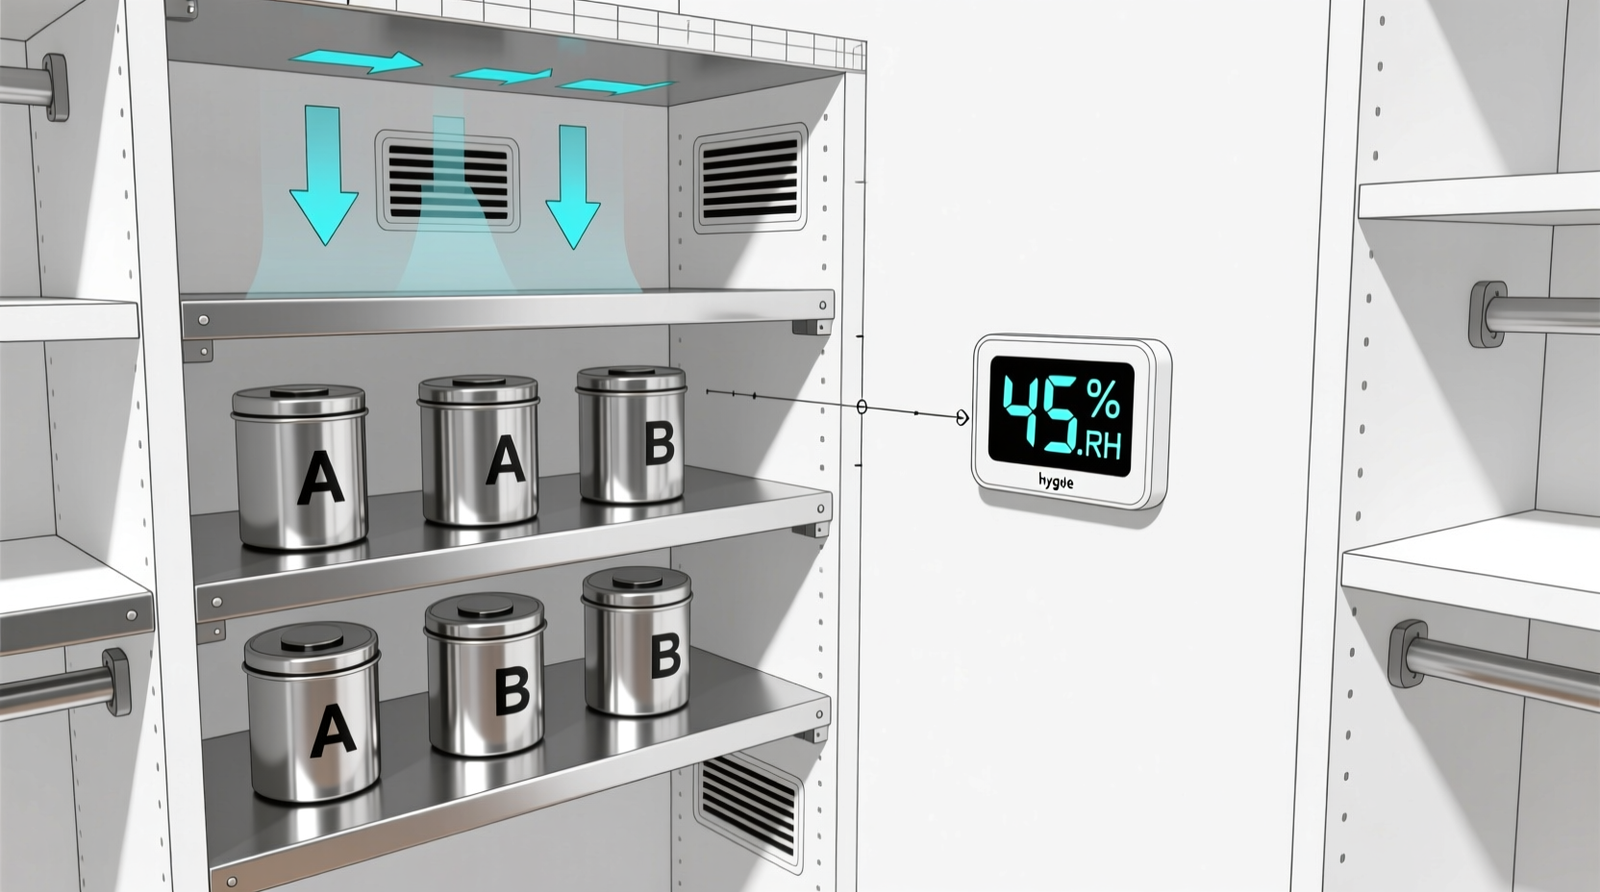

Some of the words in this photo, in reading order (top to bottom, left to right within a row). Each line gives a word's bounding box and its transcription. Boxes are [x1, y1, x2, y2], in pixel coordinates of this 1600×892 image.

[1086, 378, 1121, 419] %
[485, 434, 527, 485] A
[645, 420, 675, 466] B
[297, 450, 345, 505] A
[651, 632, 682, 679] B
[495, 666, 530, 717] B
[310, 703, 357, 759] A
